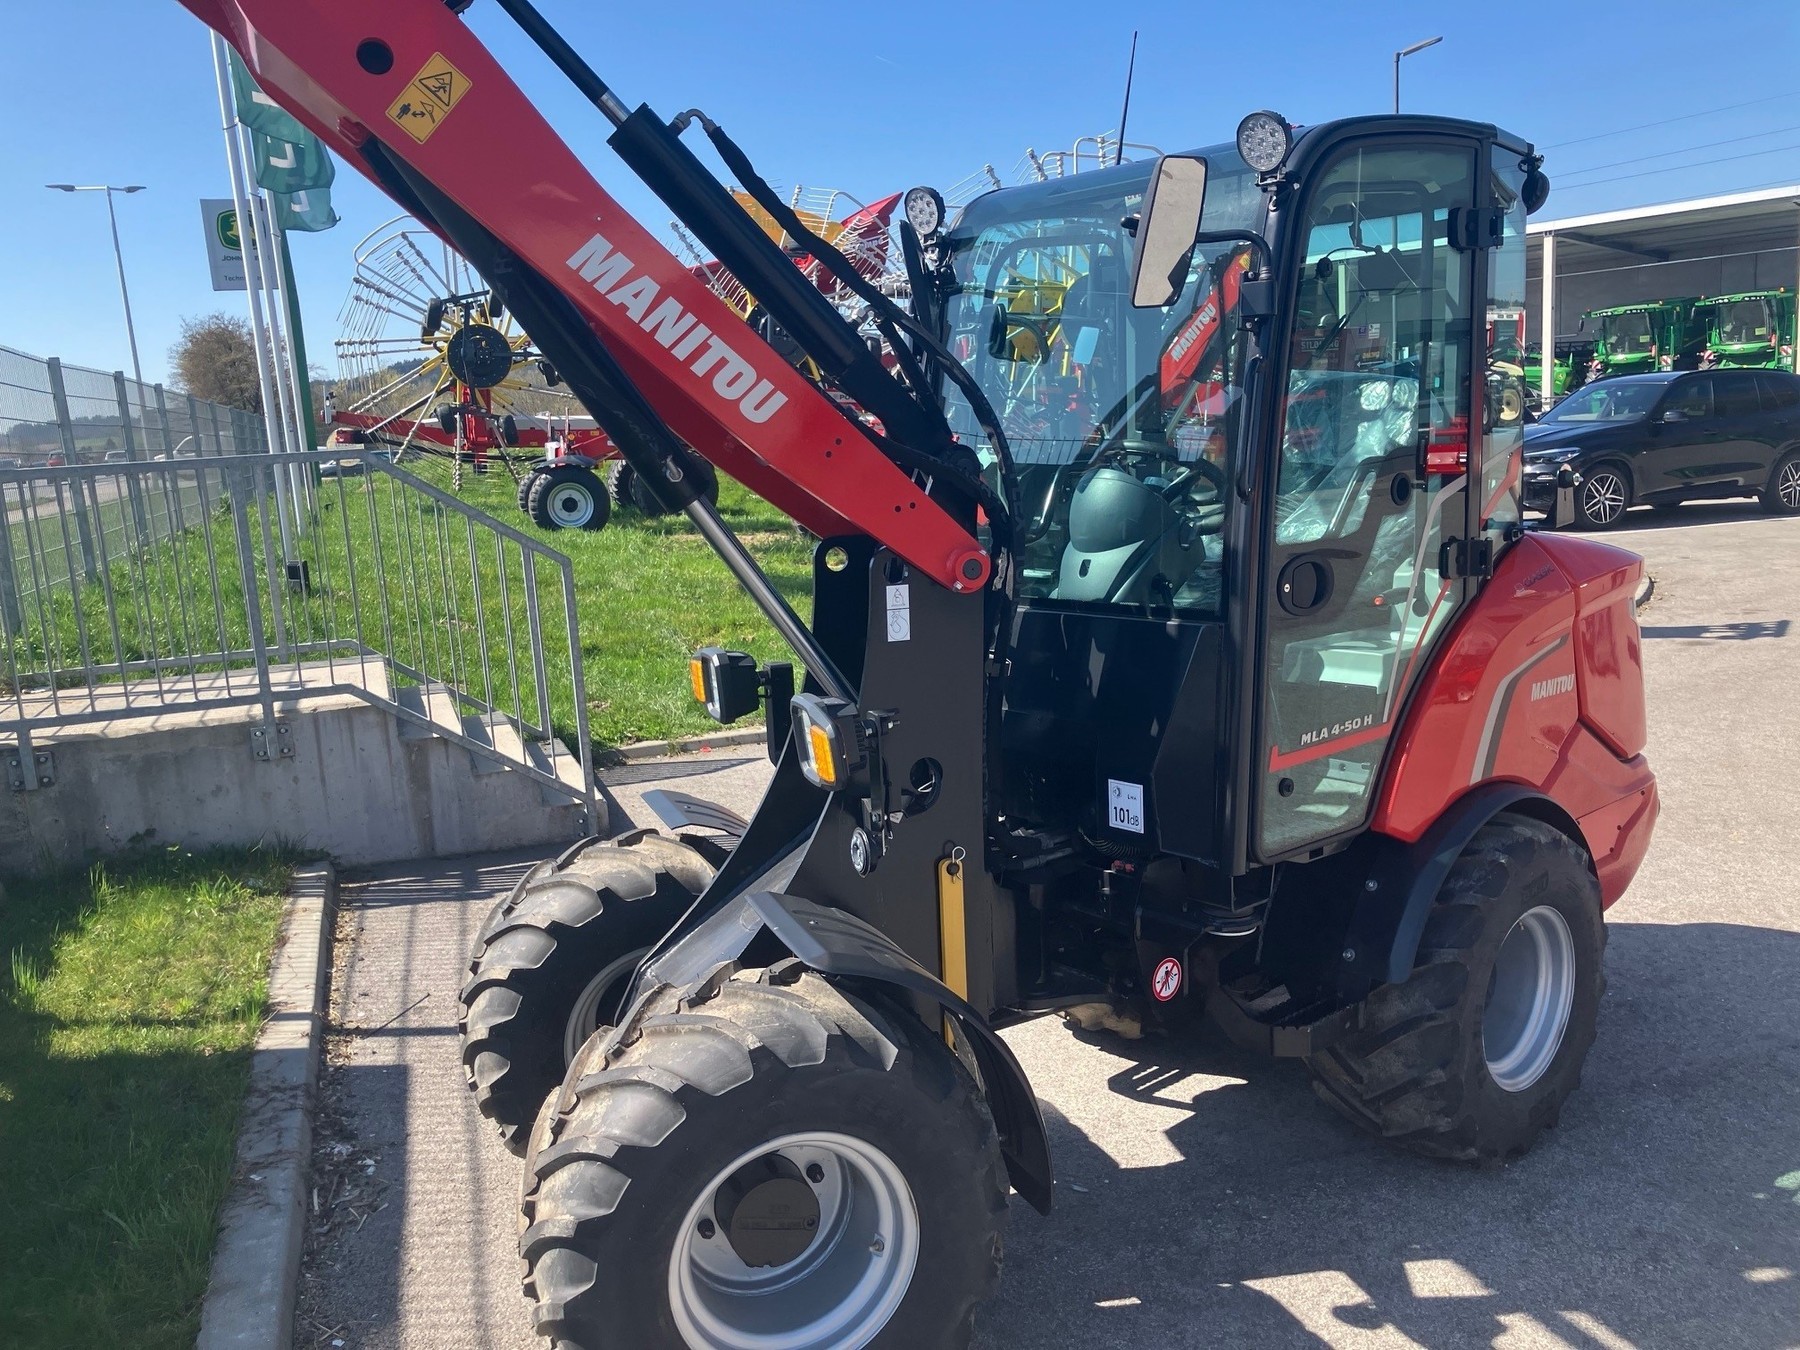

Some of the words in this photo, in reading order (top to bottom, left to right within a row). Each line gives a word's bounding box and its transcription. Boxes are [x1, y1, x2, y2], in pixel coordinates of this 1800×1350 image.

[565, 233, 789, 423] MANITOU
[1171, 303, 1216, 362] MANITOU
[1531, 674, 1575, 702] MANITOU
[1301, 727, 1329, 746] MLA
[1331, 718, 1362, 735] 4-50
[1363, 714, 1373, 726] H
